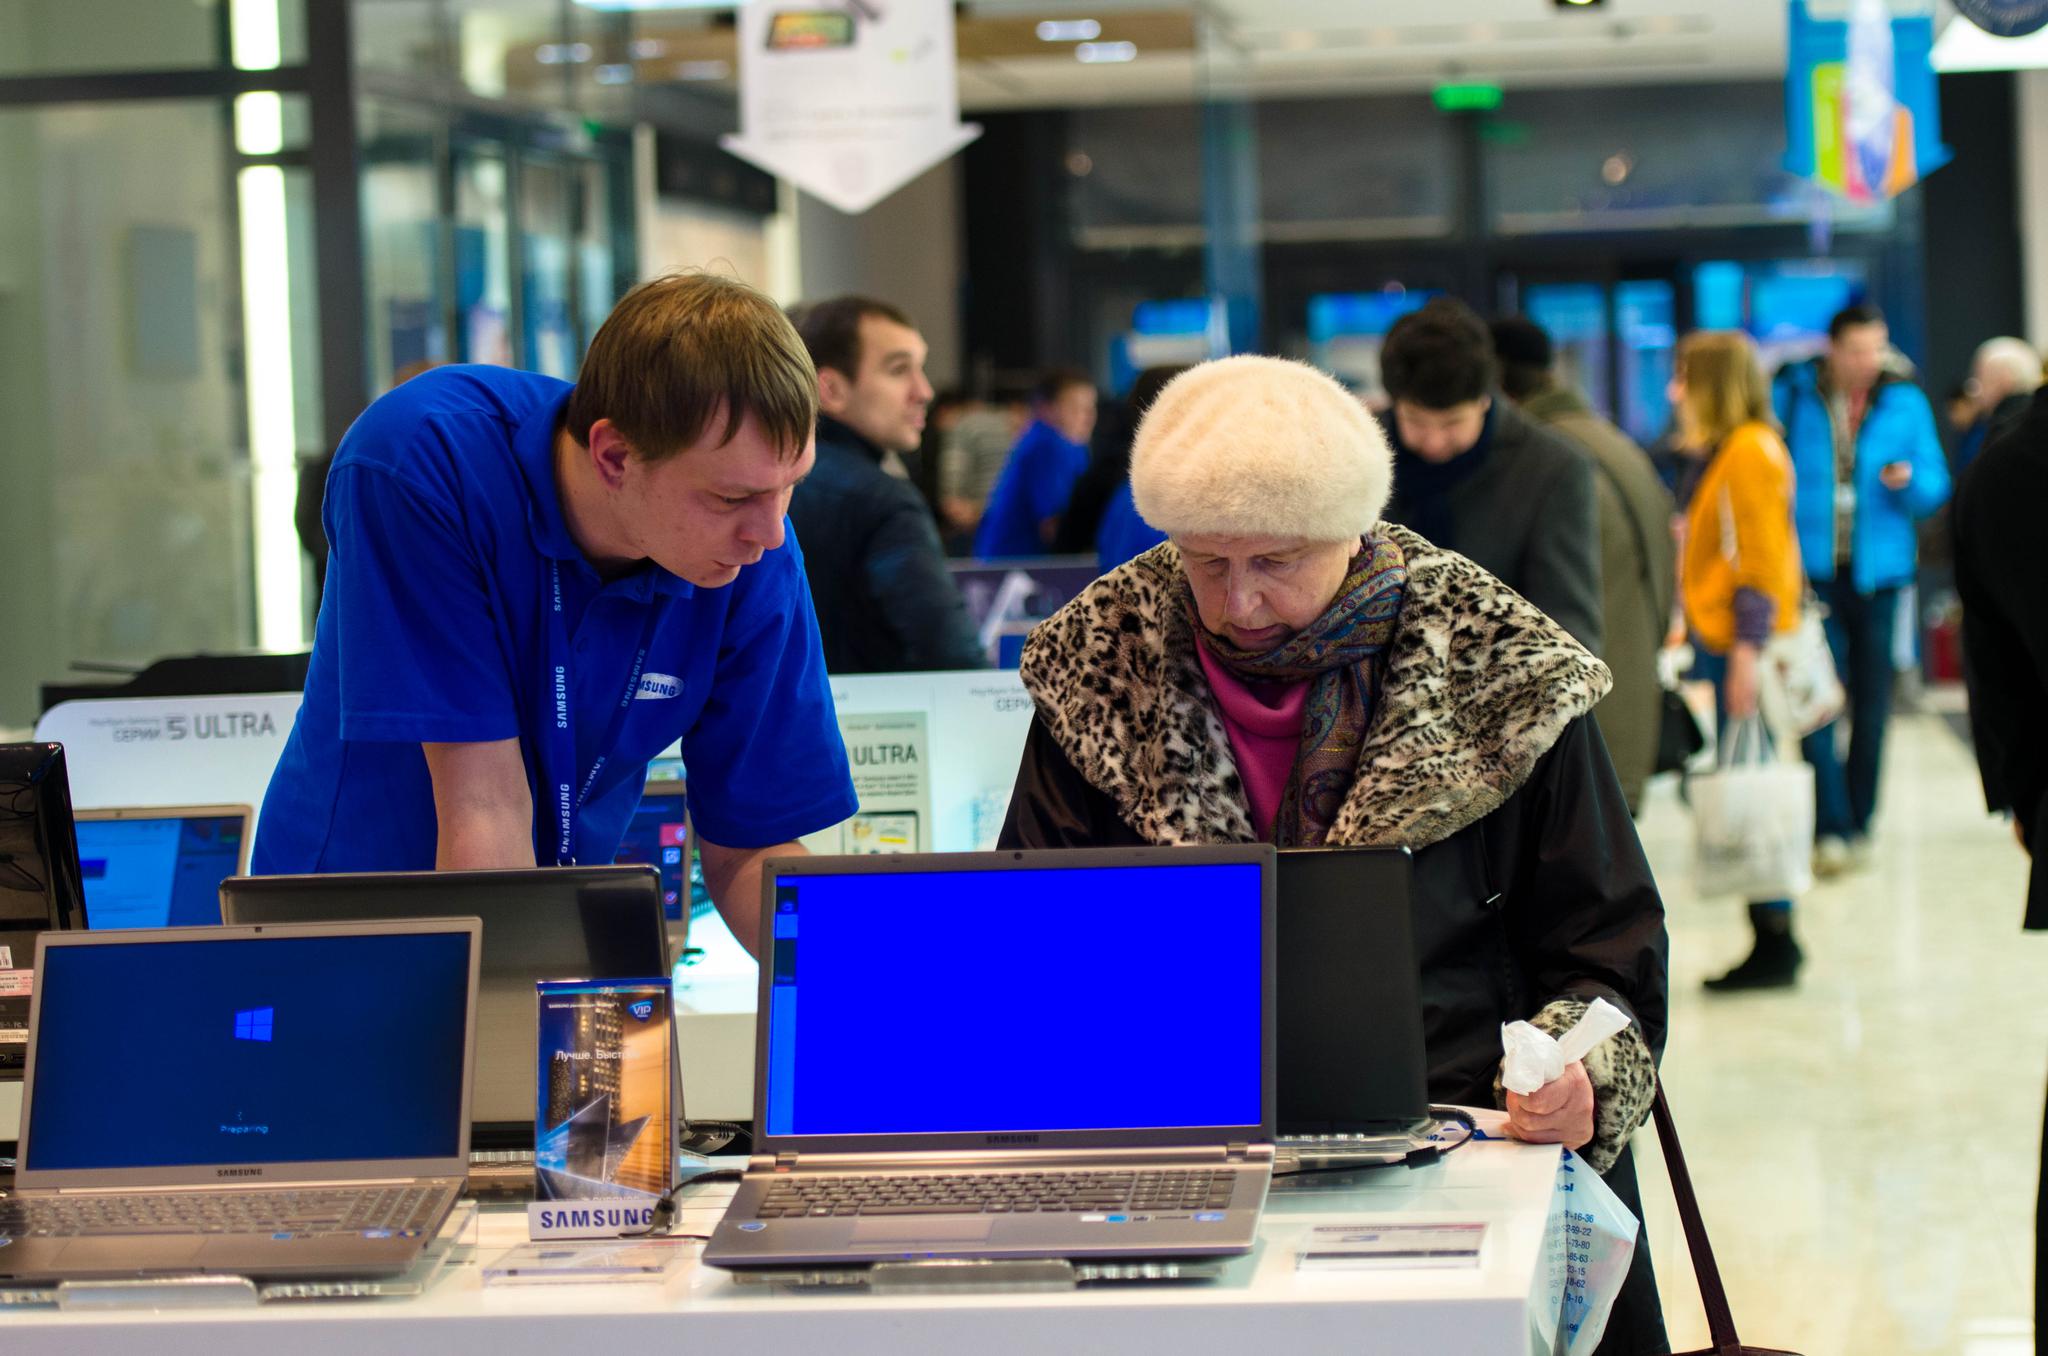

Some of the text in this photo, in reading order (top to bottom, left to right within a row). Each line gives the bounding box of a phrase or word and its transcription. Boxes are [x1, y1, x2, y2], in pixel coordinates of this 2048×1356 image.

[621, 649, 646, 708] SAMSUNG
[555, 666, 568, 728] SAMSUNG
[639, 680, 676, 697] MSUNG
[165, 716, 187, 740] 5
[194, 713, 276, 739] ULTRA
[853, 744, 918, 766] ULTRA
[633, 1004, 652, 1015] VIP
[555, 1050, 593, 1062] Лучше.
[220, 1124, 269, 1135] Preparing
[986, 1134, 1040, 1144] SAMSUNG
[217, 1167, 263, 1178] SAMSUNG
[541, 1207, 656, 1229] SAMSUNG
